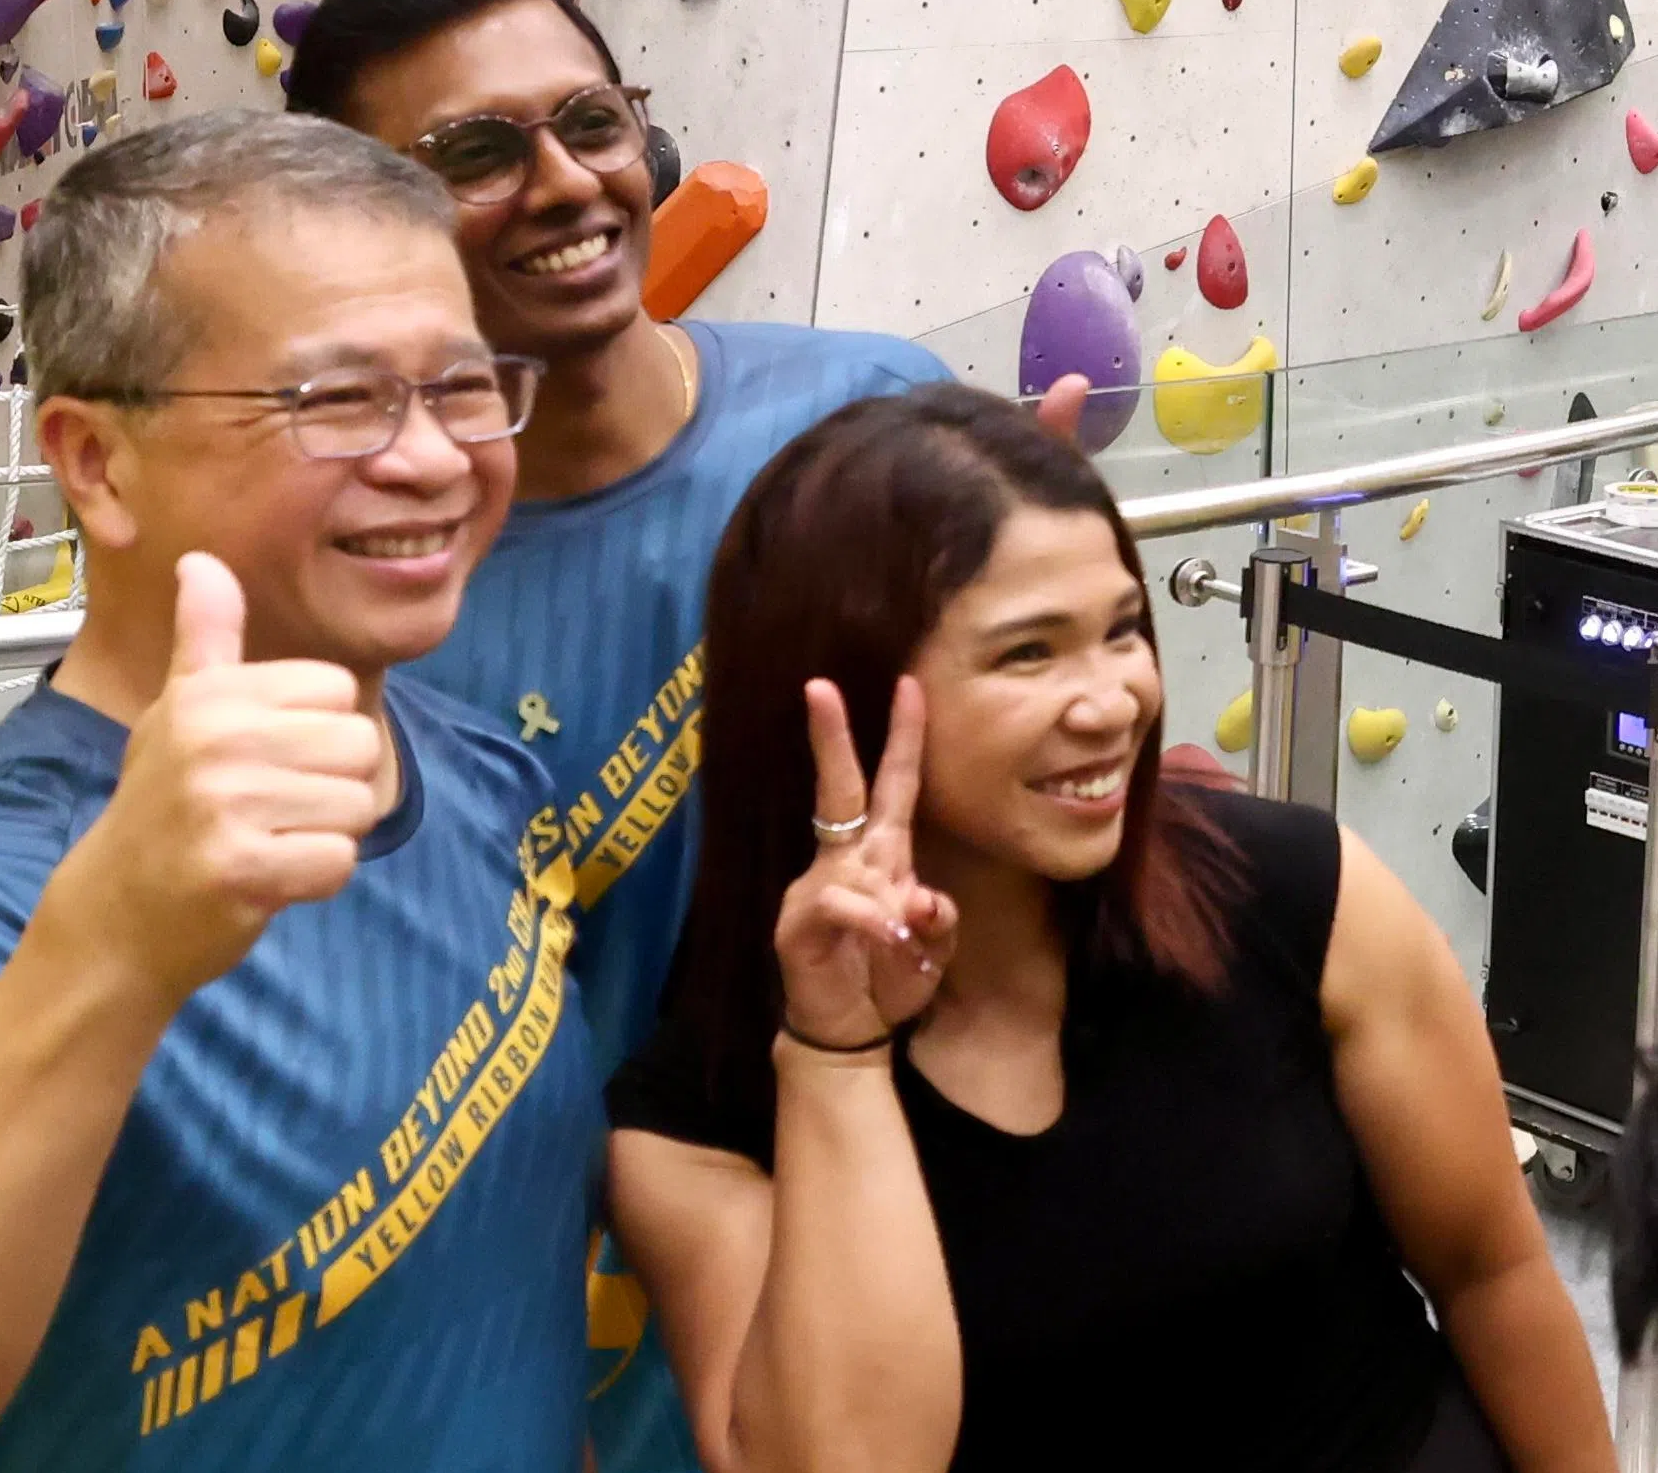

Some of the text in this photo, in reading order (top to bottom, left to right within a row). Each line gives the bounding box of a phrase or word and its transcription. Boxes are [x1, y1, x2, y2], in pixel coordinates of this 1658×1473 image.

[599, 643, 707, 800] BEYON
[131, 1324, 171, 1374] A
[185, 1168, 377, 1340] NATION
[379, 1000, 495, 1186] BEYOND
[354, 1134, 467, 1274] YELLOW
[467, 1005, 550, 1130] RIBBON
